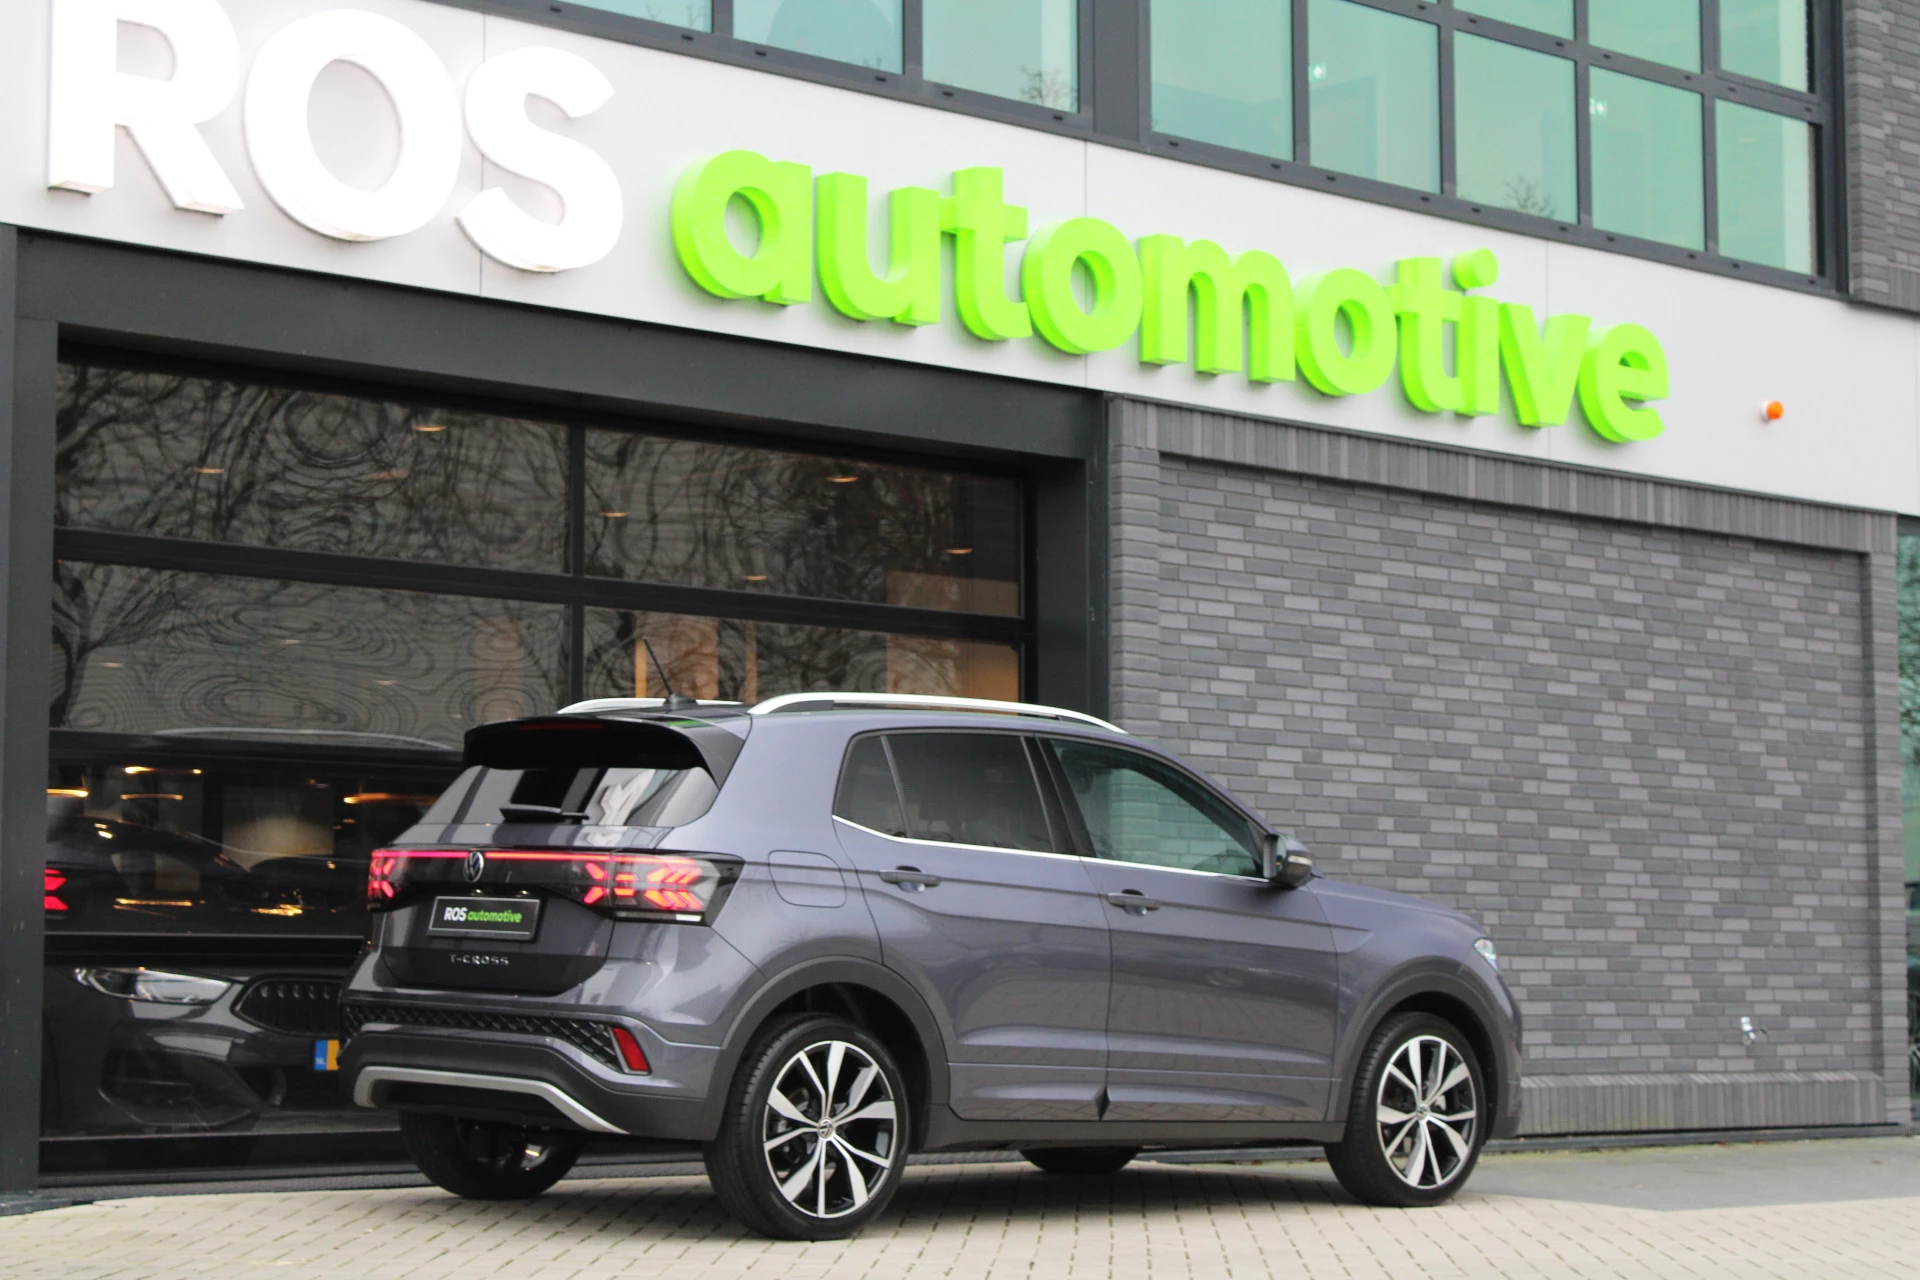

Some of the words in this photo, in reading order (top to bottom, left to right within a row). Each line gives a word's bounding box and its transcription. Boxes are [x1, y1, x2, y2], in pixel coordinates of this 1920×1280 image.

[47, 0, 623, 272] ROS
[671, 150, 1669, 443] automotive
[443, 907, 467, 921] ROS
[467, 909, 522, 923] automotive
[449, 953, 509, 966] T-CROSS
